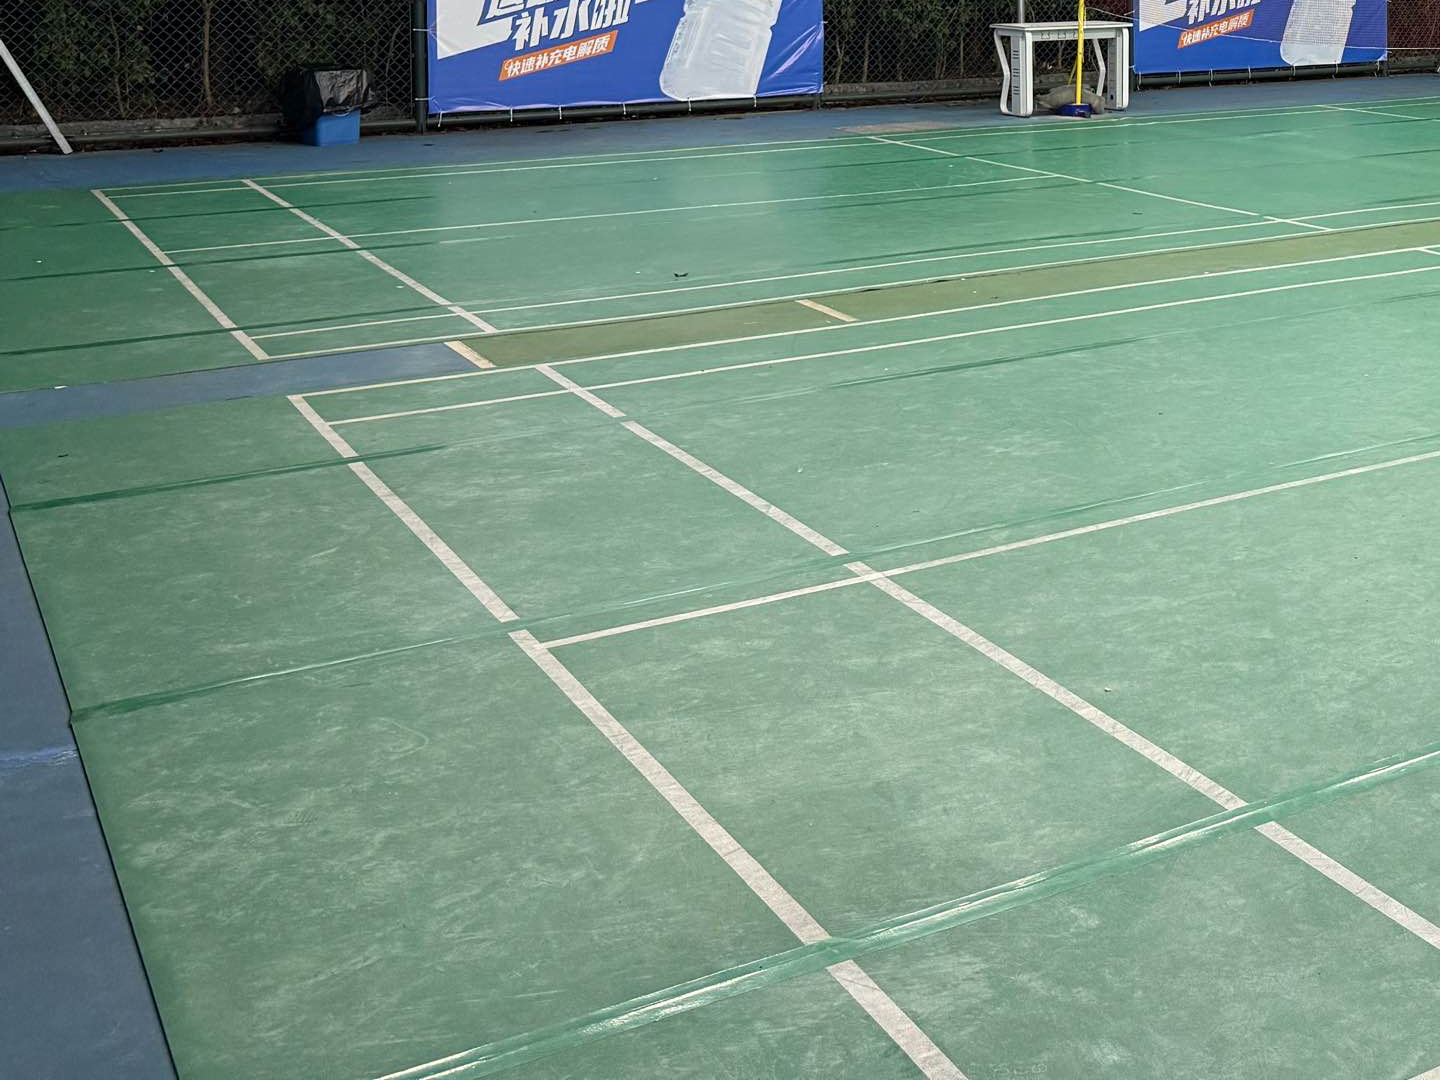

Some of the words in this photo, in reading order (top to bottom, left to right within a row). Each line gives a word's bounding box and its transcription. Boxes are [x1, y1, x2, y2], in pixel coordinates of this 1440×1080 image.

[506, 34, 611, 77] 快速补充电解质
